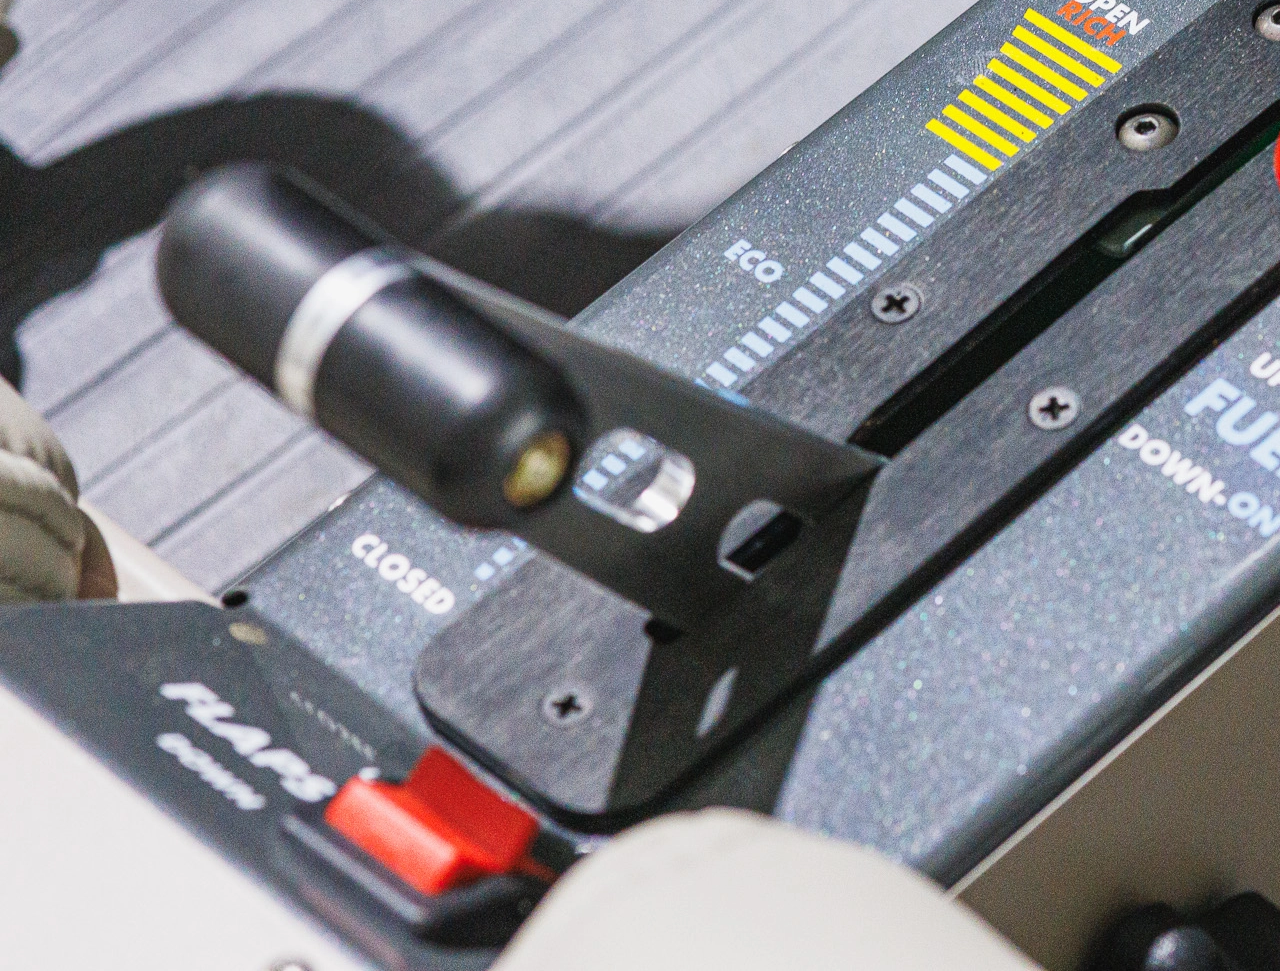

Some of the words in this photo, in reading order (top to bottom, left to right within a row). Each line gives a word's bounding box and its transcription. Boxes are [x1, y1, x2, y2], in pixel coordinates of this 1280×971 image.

[723, 238, 785, 284] ECO
[351, 533, 456, 615] CLOSED
[160, 681, 337, 803] FLAPS
